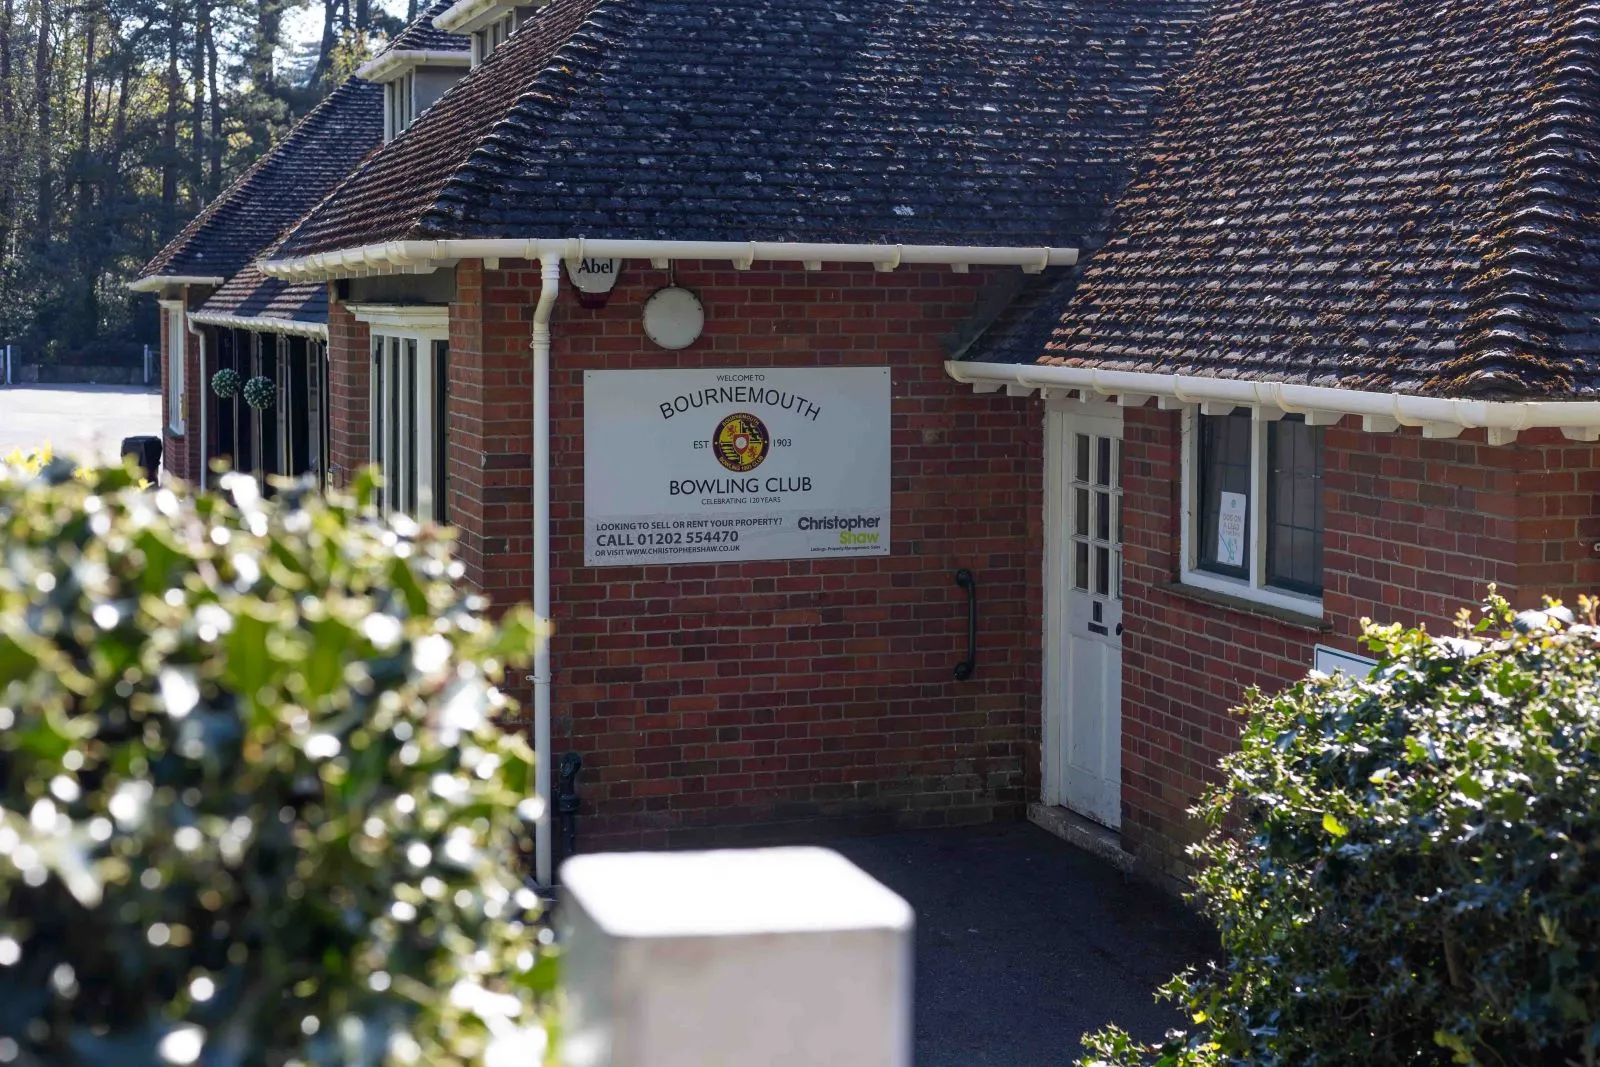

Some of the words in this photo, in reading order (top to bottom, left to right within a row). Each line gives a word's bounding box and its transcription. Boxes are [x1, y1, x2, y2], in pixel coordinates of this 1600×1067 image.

[578, 258, 613, 274] Abel
[716, 374, 754, 382] WELCOME
[659, 386, 821, 421] BOURNEMOUTH
[693, 440, 710, 449] EST
[773, 438, 792, 448] 1903
[669, 478, 759, 495] BOWLING
[765, 476, 812, 492] CLUB
[701, 497, 747, 505] CELEBRATING
[596, 522, 637, 531] LOOKING
[638, 522, 649, 530] TO
[651, 521, 671, 530] SELL
[672, 521, 685, 529] OR
[686, 520, 709, 528] RENT
[709, 519, 734, 527] YOUR
[735, 517, 783, 527] PROPERTY?
[797, 515, 881, 531] Christopher
[596, 533, 635, 547] CALL
[637, 532, 682, 545] 01202
[685, 530, 739, 543] 554470
[839, 530, 880, 545] Shaw
[595, 549, 606, 557] OR
[625, 545, 740, 556] WWW.CHRISTOPHERSHAW.CO.UK
